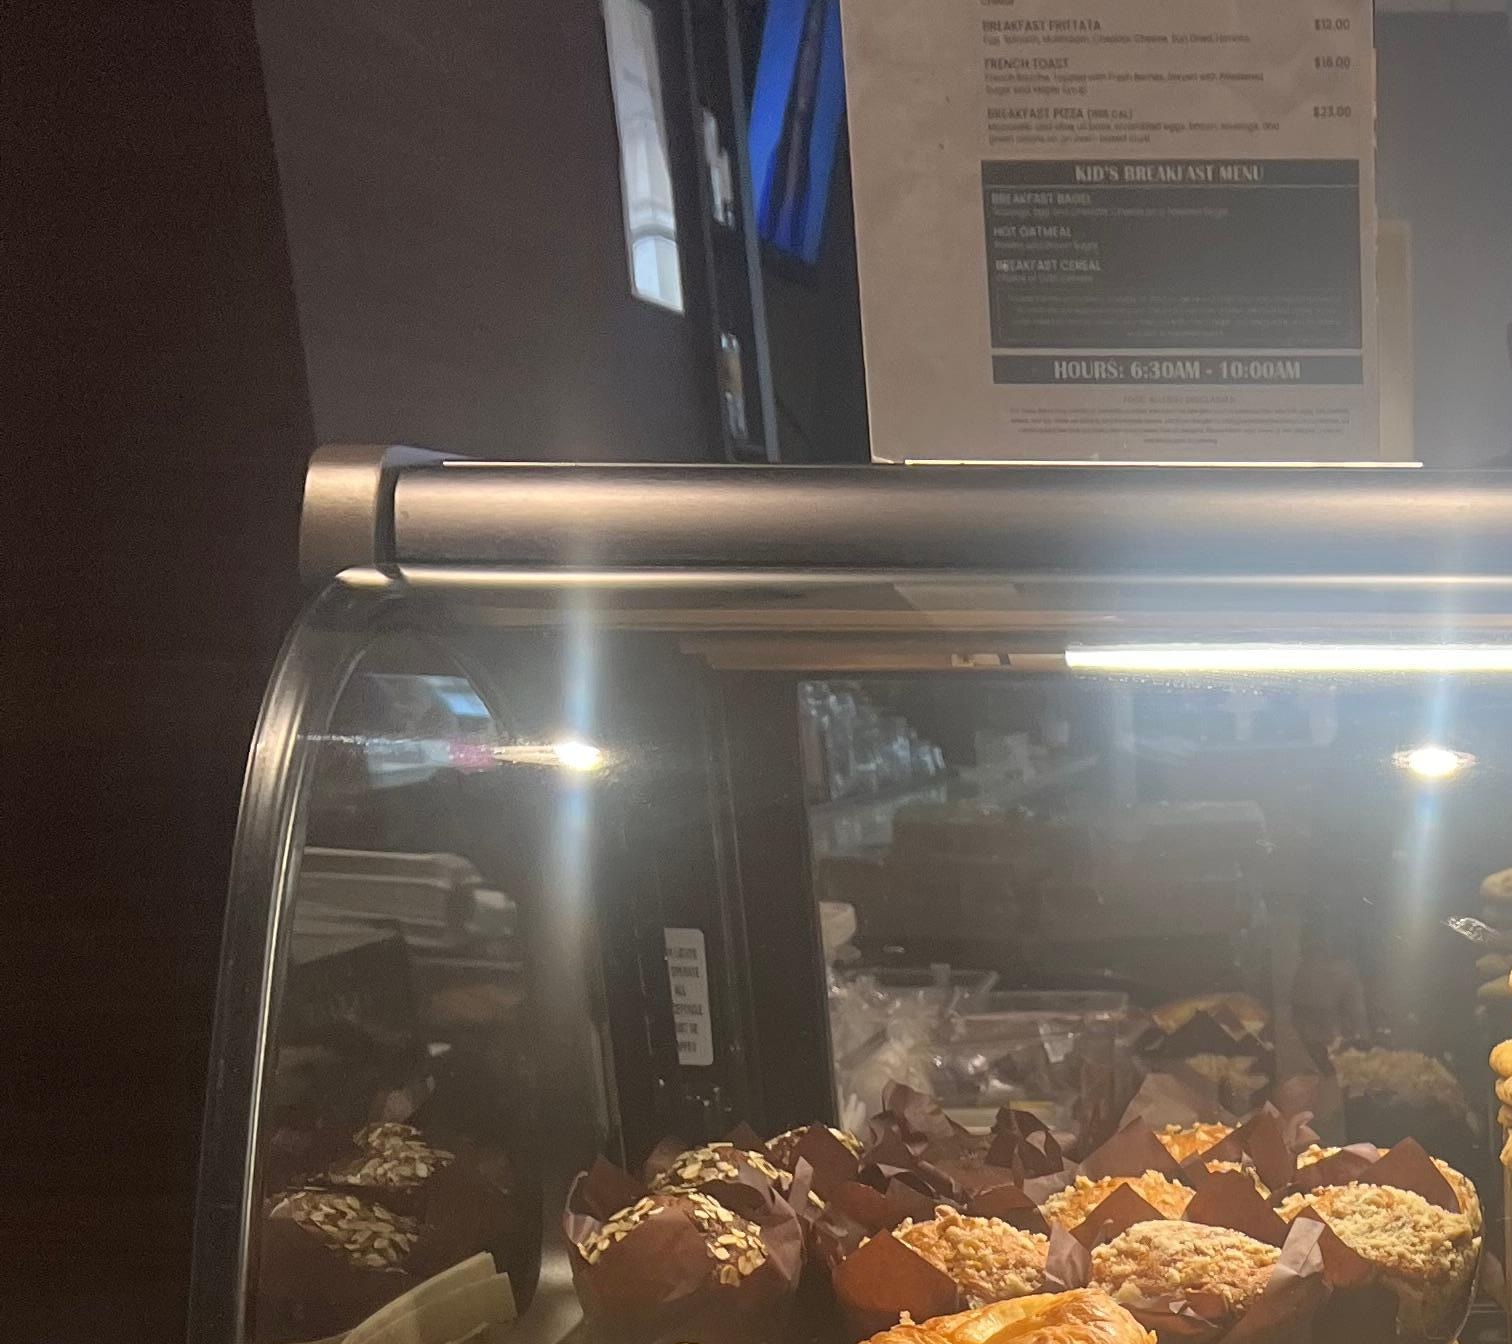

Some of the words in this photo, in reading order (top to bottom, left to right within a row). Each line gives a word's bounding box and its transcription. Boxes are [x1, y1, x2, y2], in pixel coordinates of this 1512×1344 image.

[1074, 165, 1119, 181] KID'S
[1124, 164, 1215, 181] BREAKFAST
[1219, 164, 1265, 181] MENU
[1054, 361, 1125, 380] HOURS:
[1130, 361, 1201, 380] 6:30AM
[1220, 361, 1301, 380] 10:00AM
